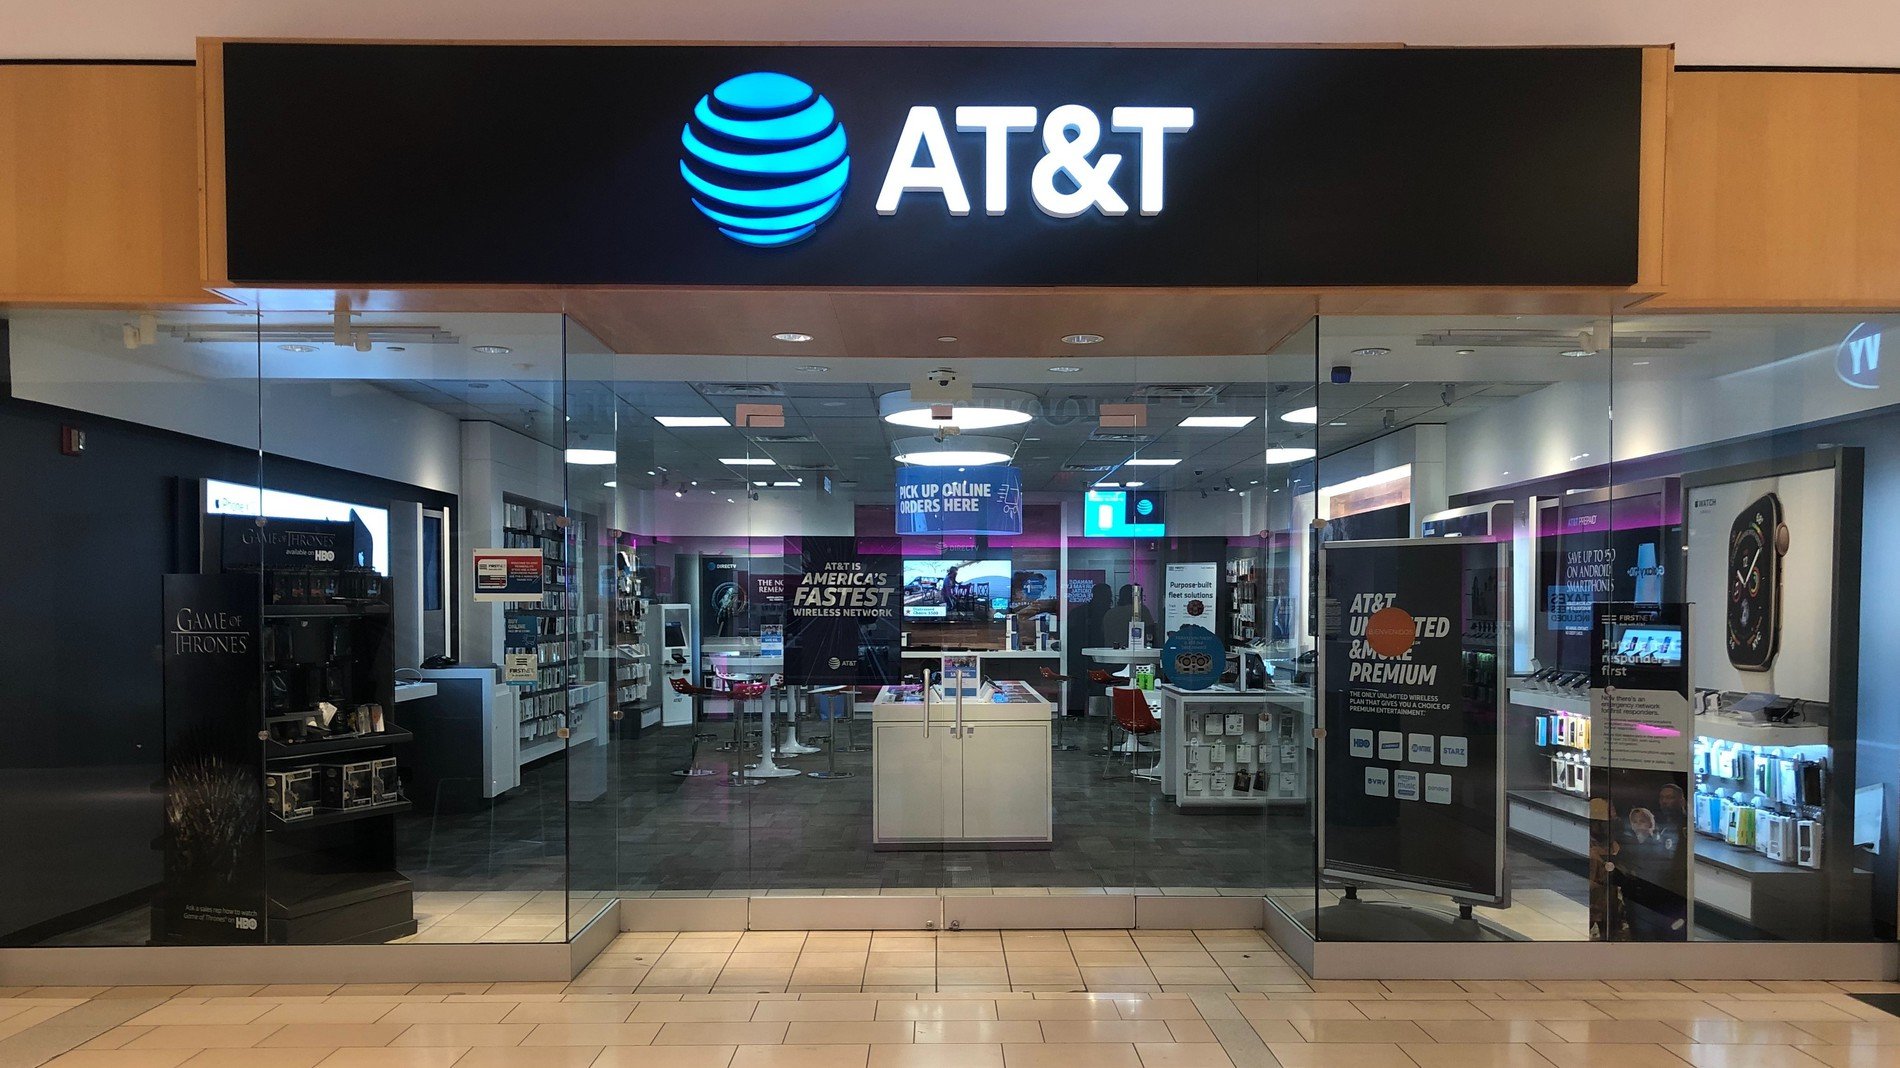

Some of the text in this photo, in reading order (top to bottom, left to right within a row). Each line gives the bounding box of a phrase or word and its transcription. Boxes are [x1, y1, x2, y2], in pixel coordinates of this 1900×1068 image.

[875, 103, 1194, 218] AT&T
[900, 483, 991, 499] PICK UP ONLINE
[900, 498, 979, 514] ORDERS HERE
[242, 528, 276, 545] GAME
[286, 531, 335, 548] THRONES
[315, 550, 335, 562] HBO
[1568, 551, 1581, 564] SAVE
[1583, 550, 1593, 563] UP
[1594, 549, 1603, 562] TO
[824, 562, 861, 571] AT&T IS
[1567, 566, 1578, 578] ON
[757, 579, 772, 587] THE
[1170, 581, 1212, 589] Purpose-built
[793, 587, 895, 607] FASTEST
[1350, 593, 1397, 614] AT&T
[793, 608, 892, 617] WIRELESS NETWORK
[176, 607, 242, 632] GAME OF
[171, 631, 250, 655] THRONES
[1602, 654, 1671, 665] responders
[1349, 662, 1437, 686] PREMIUM
[1601, 665, 1627, 677] first
[1377, 692, 1408, 700] UNLIMITED
[1409, 694, 1438, 702] WIRELESS
[1417, 702, 1441, 710] CHOICE
[1354, 738, 1371, 748] HBO
[1443, 747, 1465, 756] STARZ
[235, 916, 257, 930] HBO
